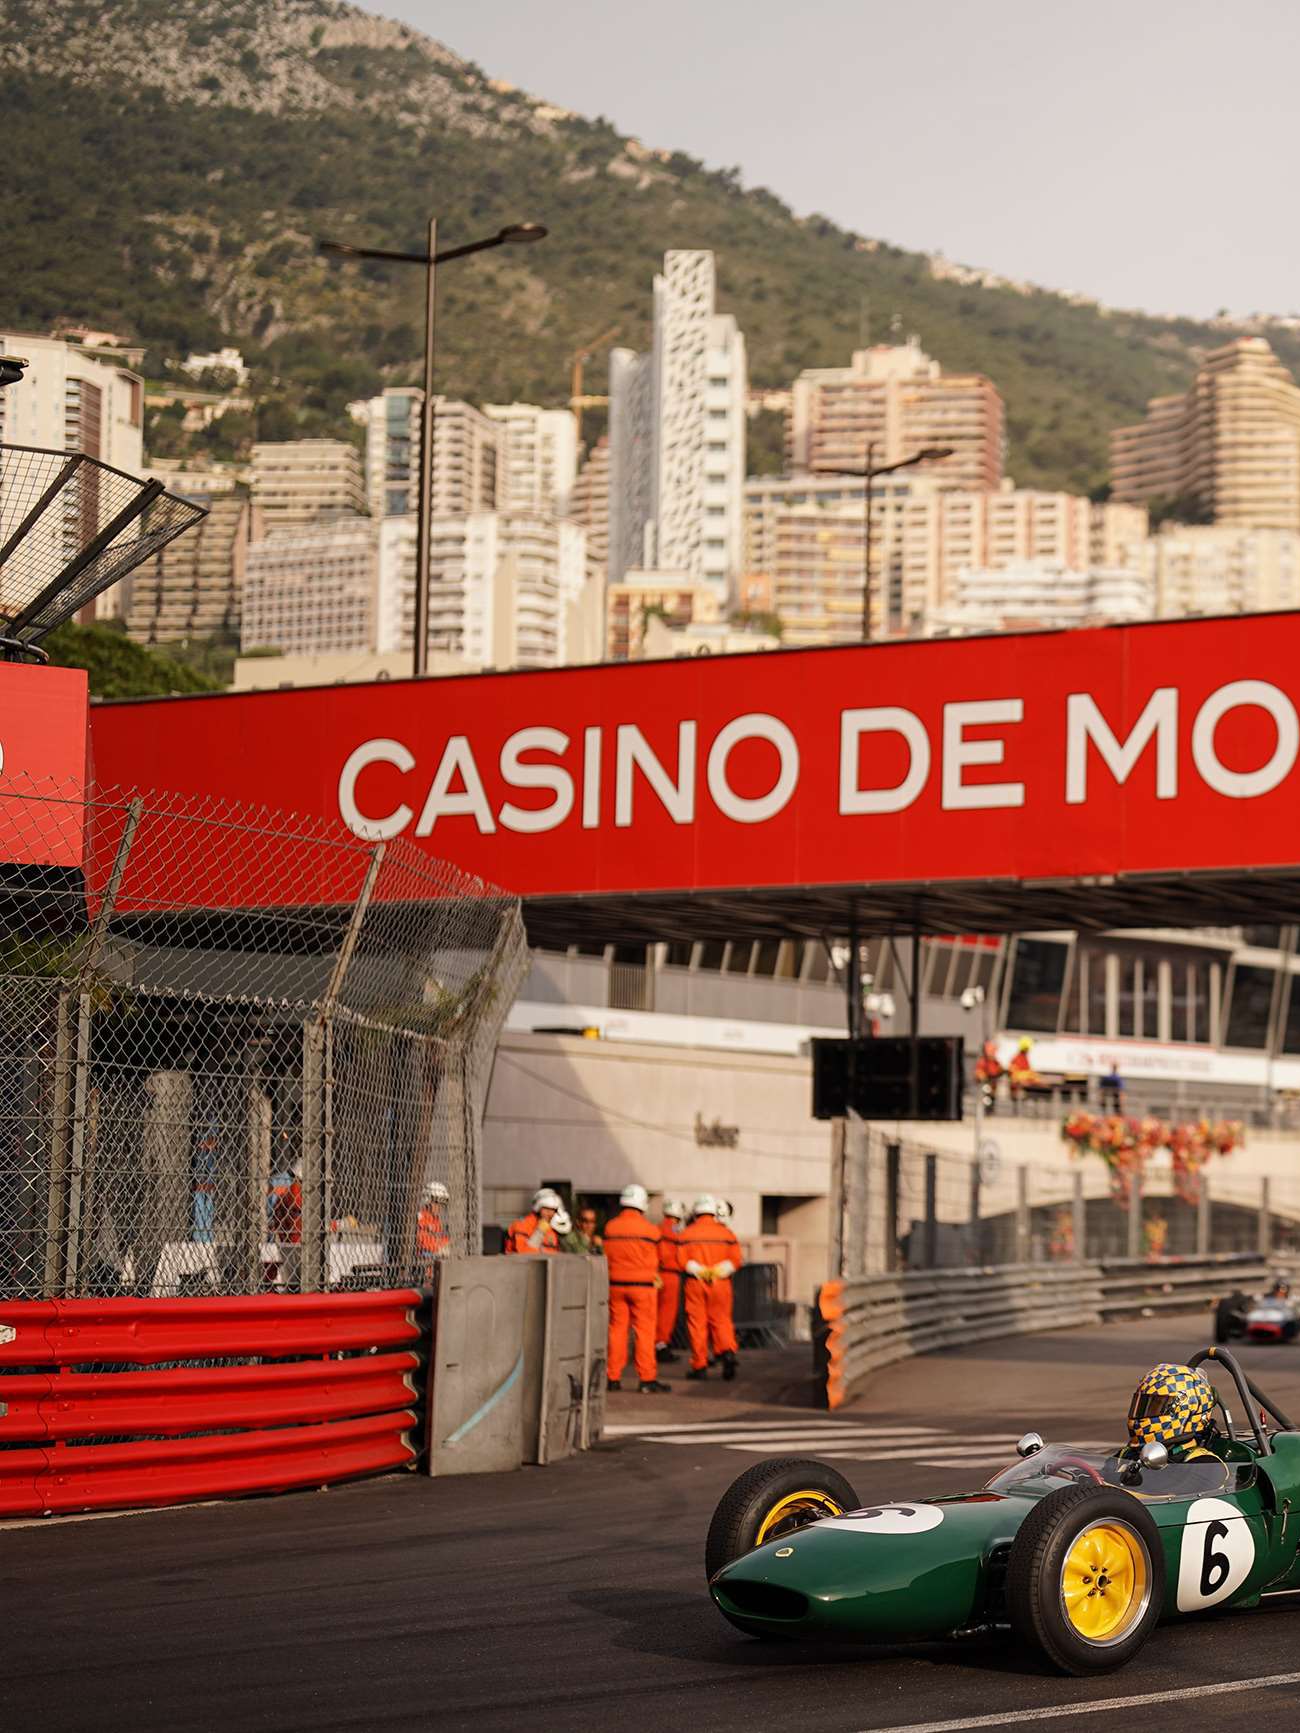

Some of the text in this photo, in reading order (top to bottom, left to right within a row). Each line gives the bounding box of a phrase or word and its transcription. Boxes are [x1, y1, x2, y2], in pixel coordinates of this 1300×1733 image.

[338, 707, 800, 841] CASINO
[839, 699, 1025, 815] DE
[1200, 1520, 1231, 1597] 6
